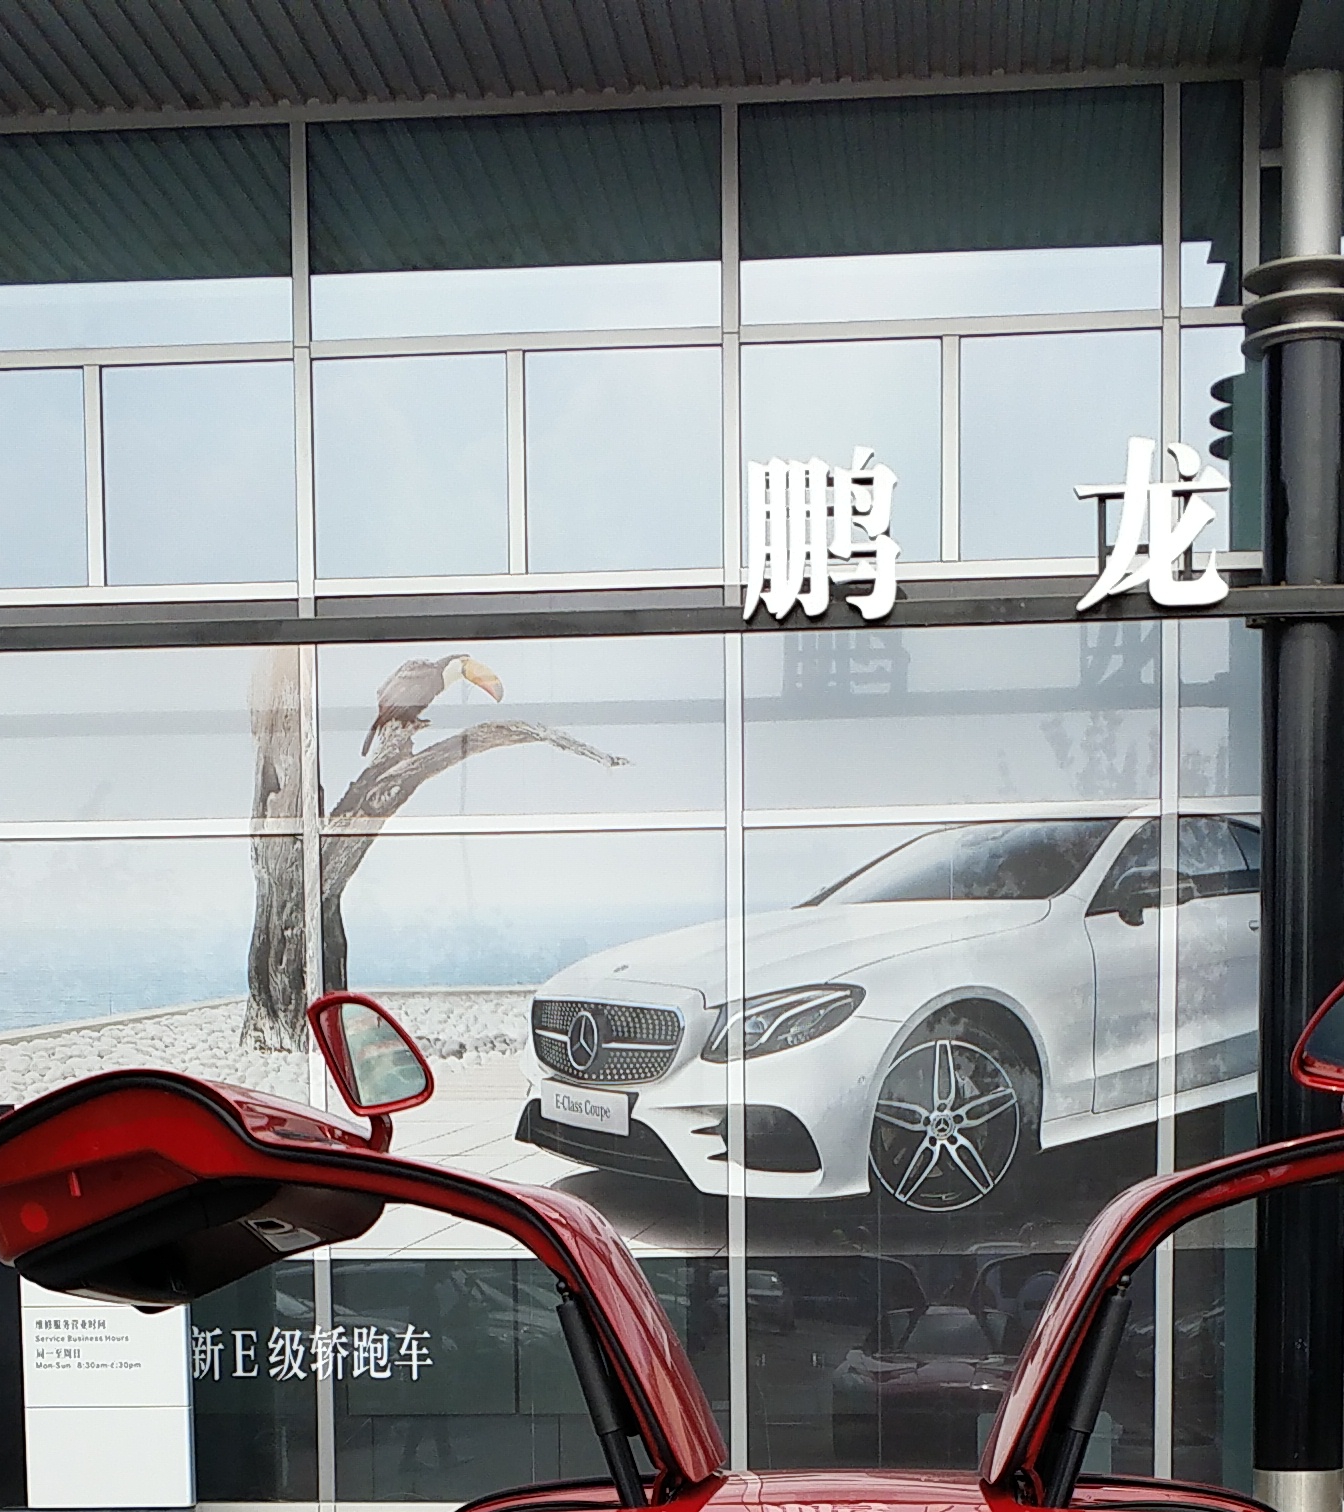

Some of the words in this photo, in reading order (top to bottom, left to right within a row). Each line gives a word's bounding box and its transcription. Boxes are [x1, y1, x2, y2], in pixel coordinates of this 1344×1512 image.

[555, 1092, 583, 1114] E-Class
[584, 1099, 611, 1122] Coupe
[34, 1334, 65, 1343] Service
[67, 1334, 103, 1343] Business
[104, 1334, 130, 1343] Hours
